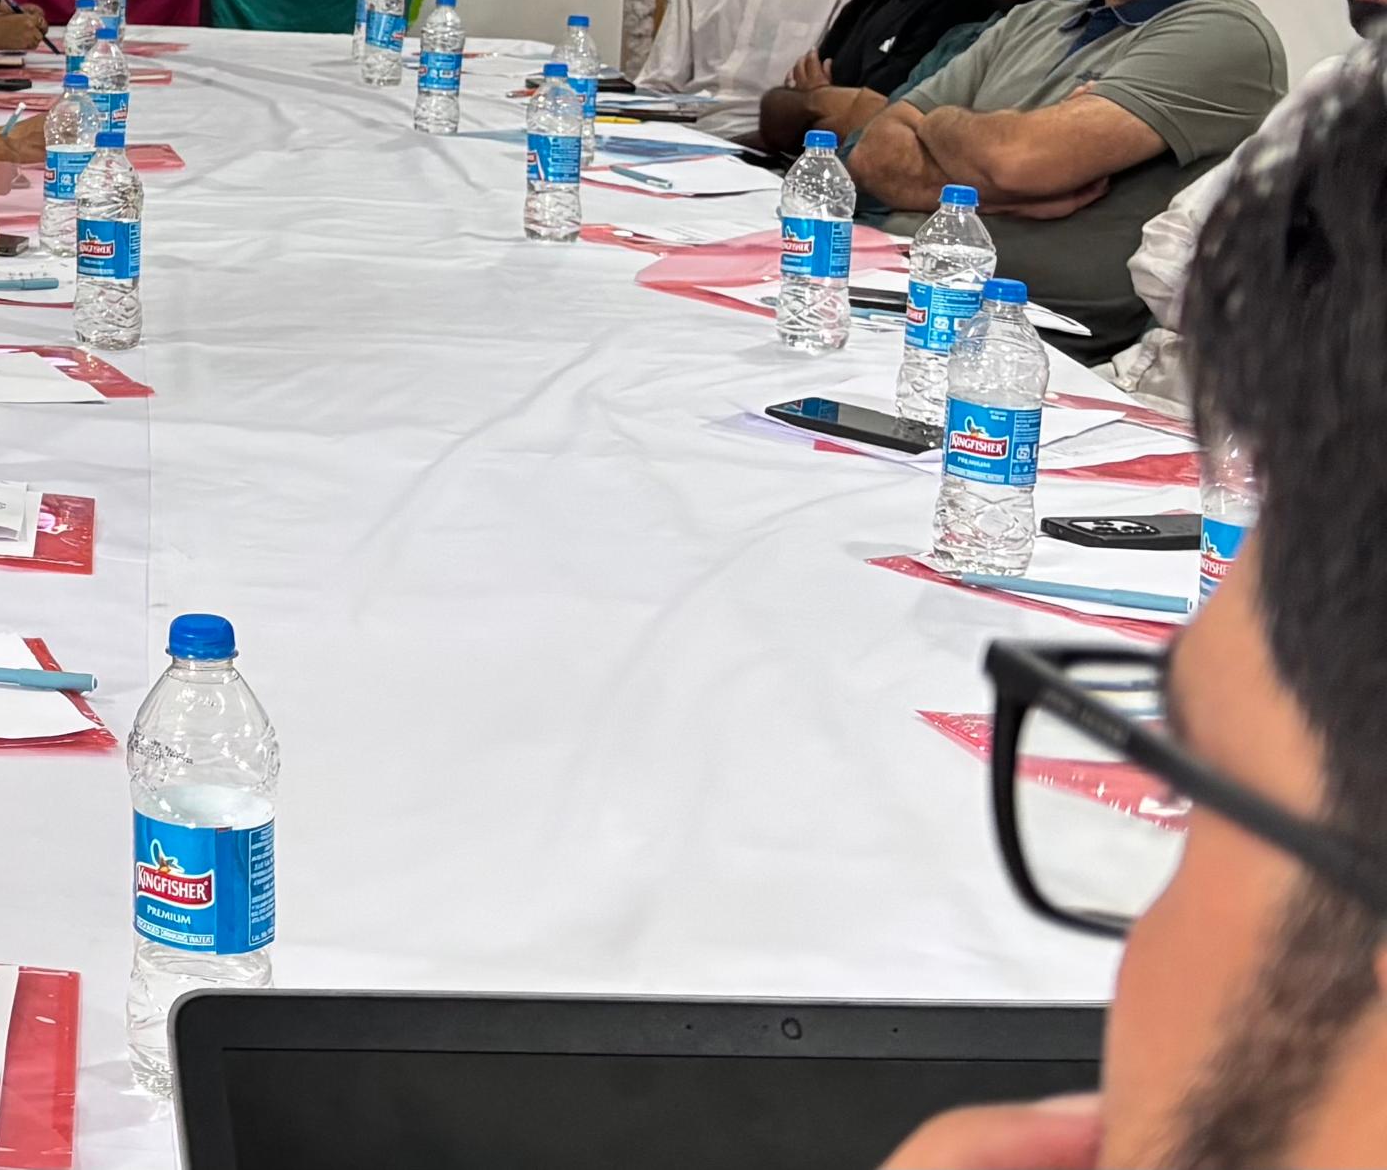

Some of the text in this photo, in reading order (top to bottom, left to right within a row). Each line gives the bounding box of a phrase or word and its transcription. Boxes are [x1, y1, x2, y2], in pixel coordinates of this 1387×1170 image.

[951, 432, 1003, 455] KINGFISHER
[137, 865, 209, 902] KINGFISHER
[146, 904, 192, 925] PREMIUM
